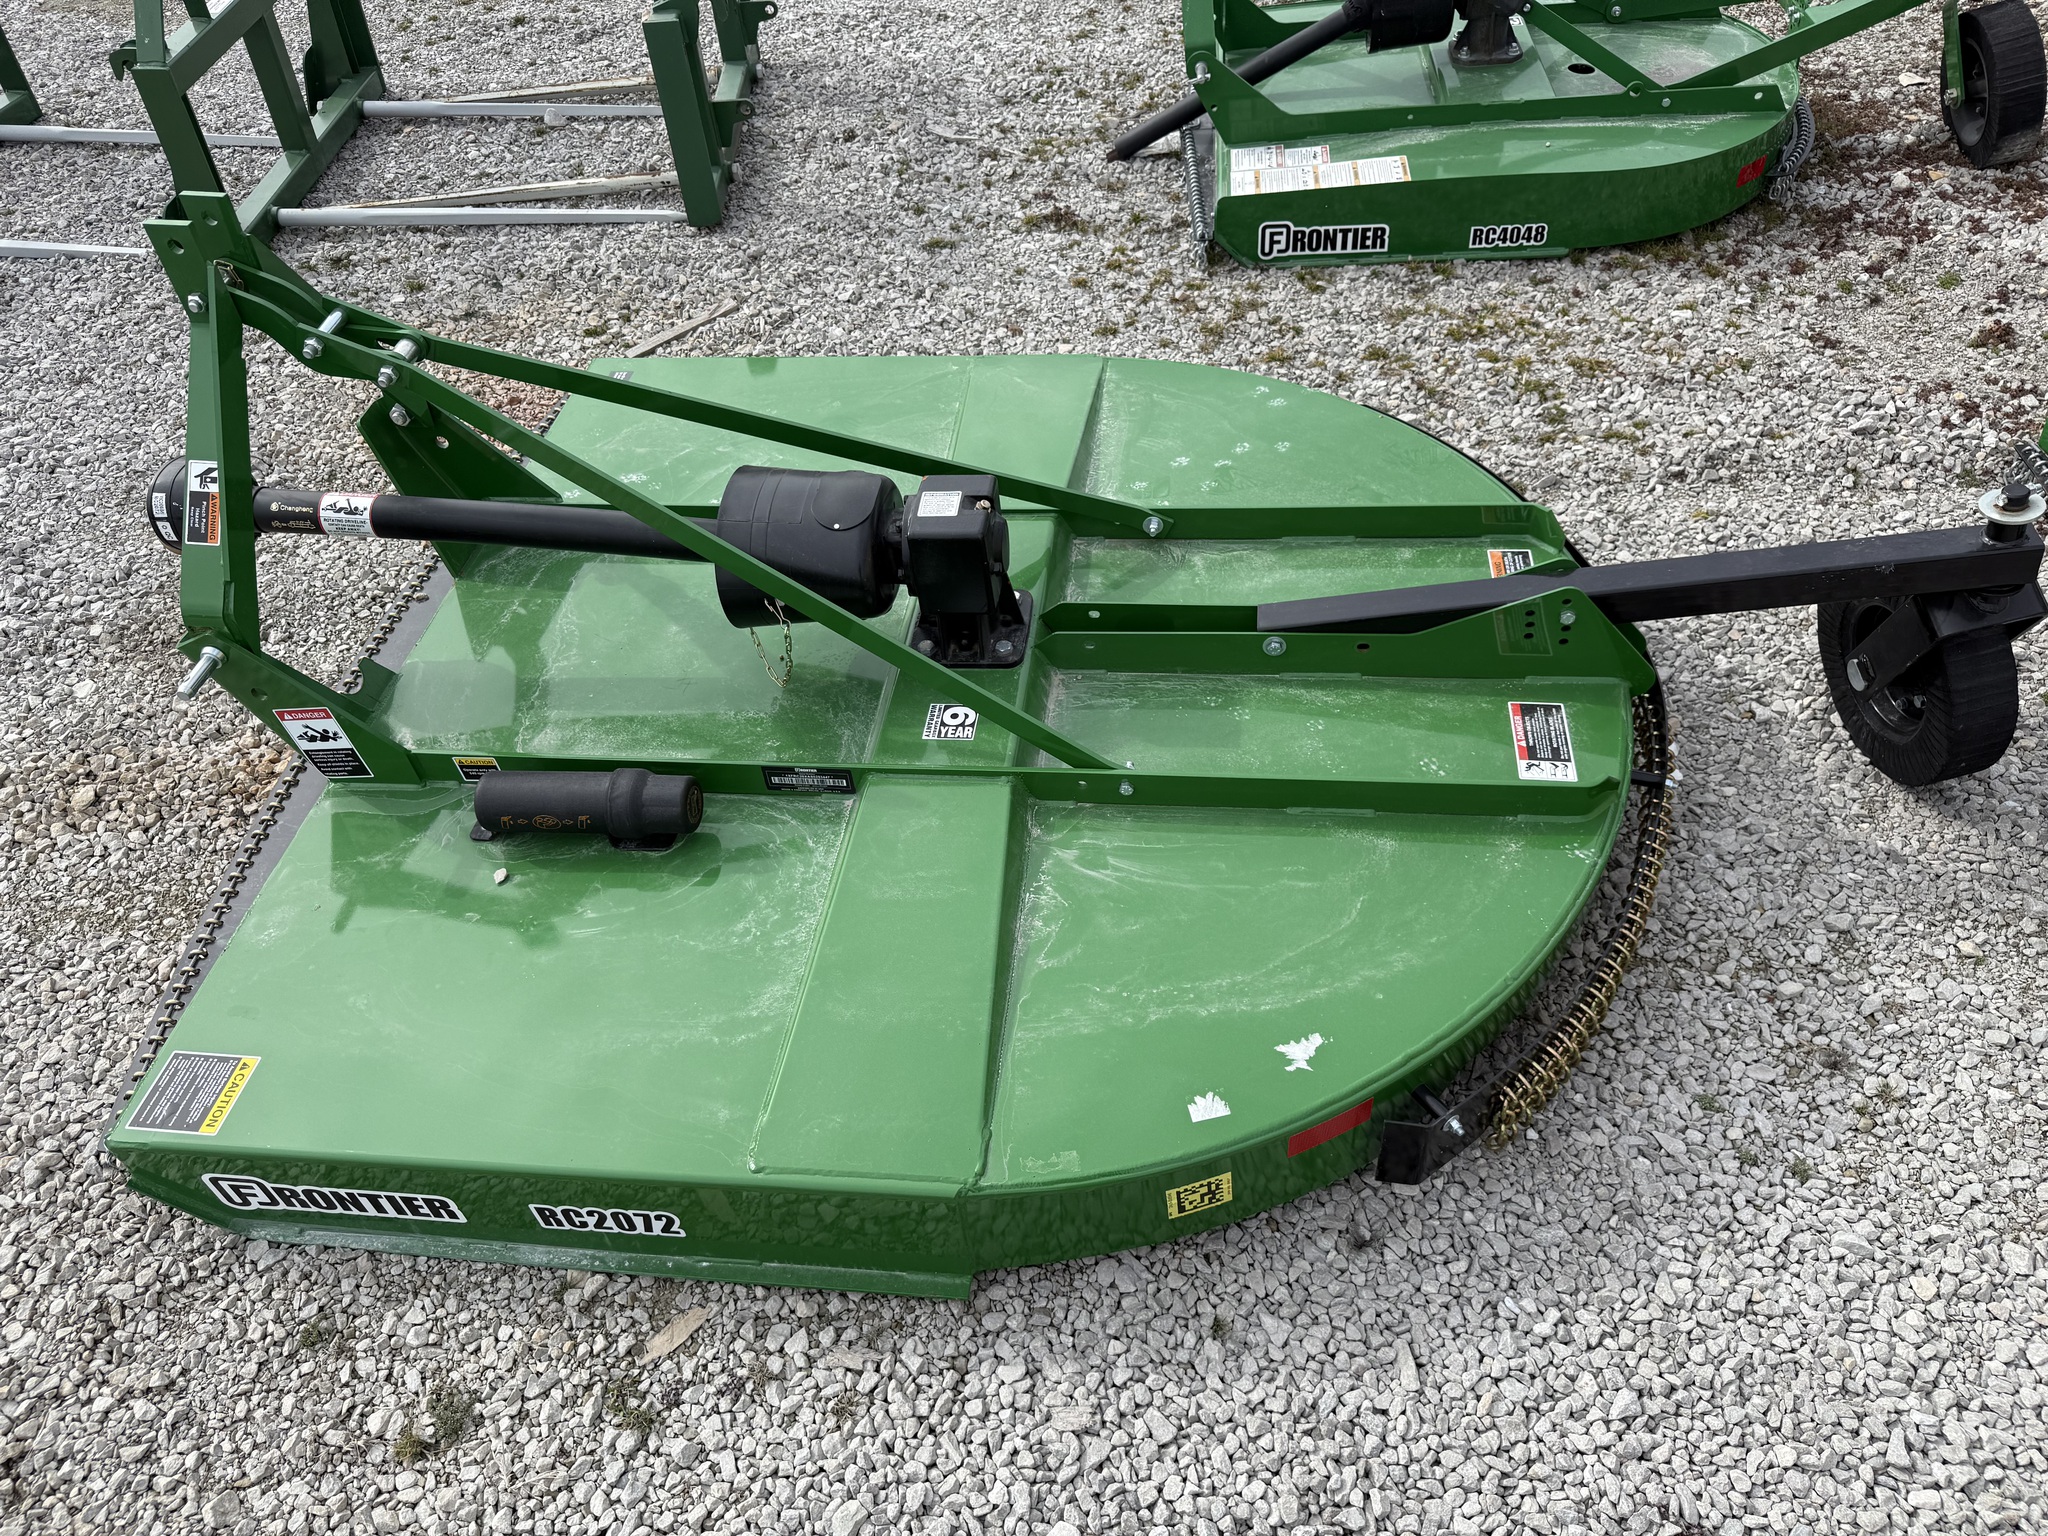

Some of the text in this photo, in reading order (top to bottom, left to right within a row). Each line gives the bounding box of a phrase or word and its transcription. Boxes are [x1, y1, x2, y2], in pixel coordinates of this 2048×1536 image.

[1261, 224, 1387, 257] FRONTIER
[1471, 225, 1547, 247] RC4048
[210, 502, 218, 540] WARNING
[280, 504, 314, 513] Changhong
[924, 705, 937, 737] WARRANTY
[940, 726, 973, 738] YEAR
[1514, 716, 1525, 739] DANGER
[206, 1073, 245, 1128] CAUTION
[207, 1176, 463, 1221] FRONTIER
[533, 1206, 682, 1235] RC2072
